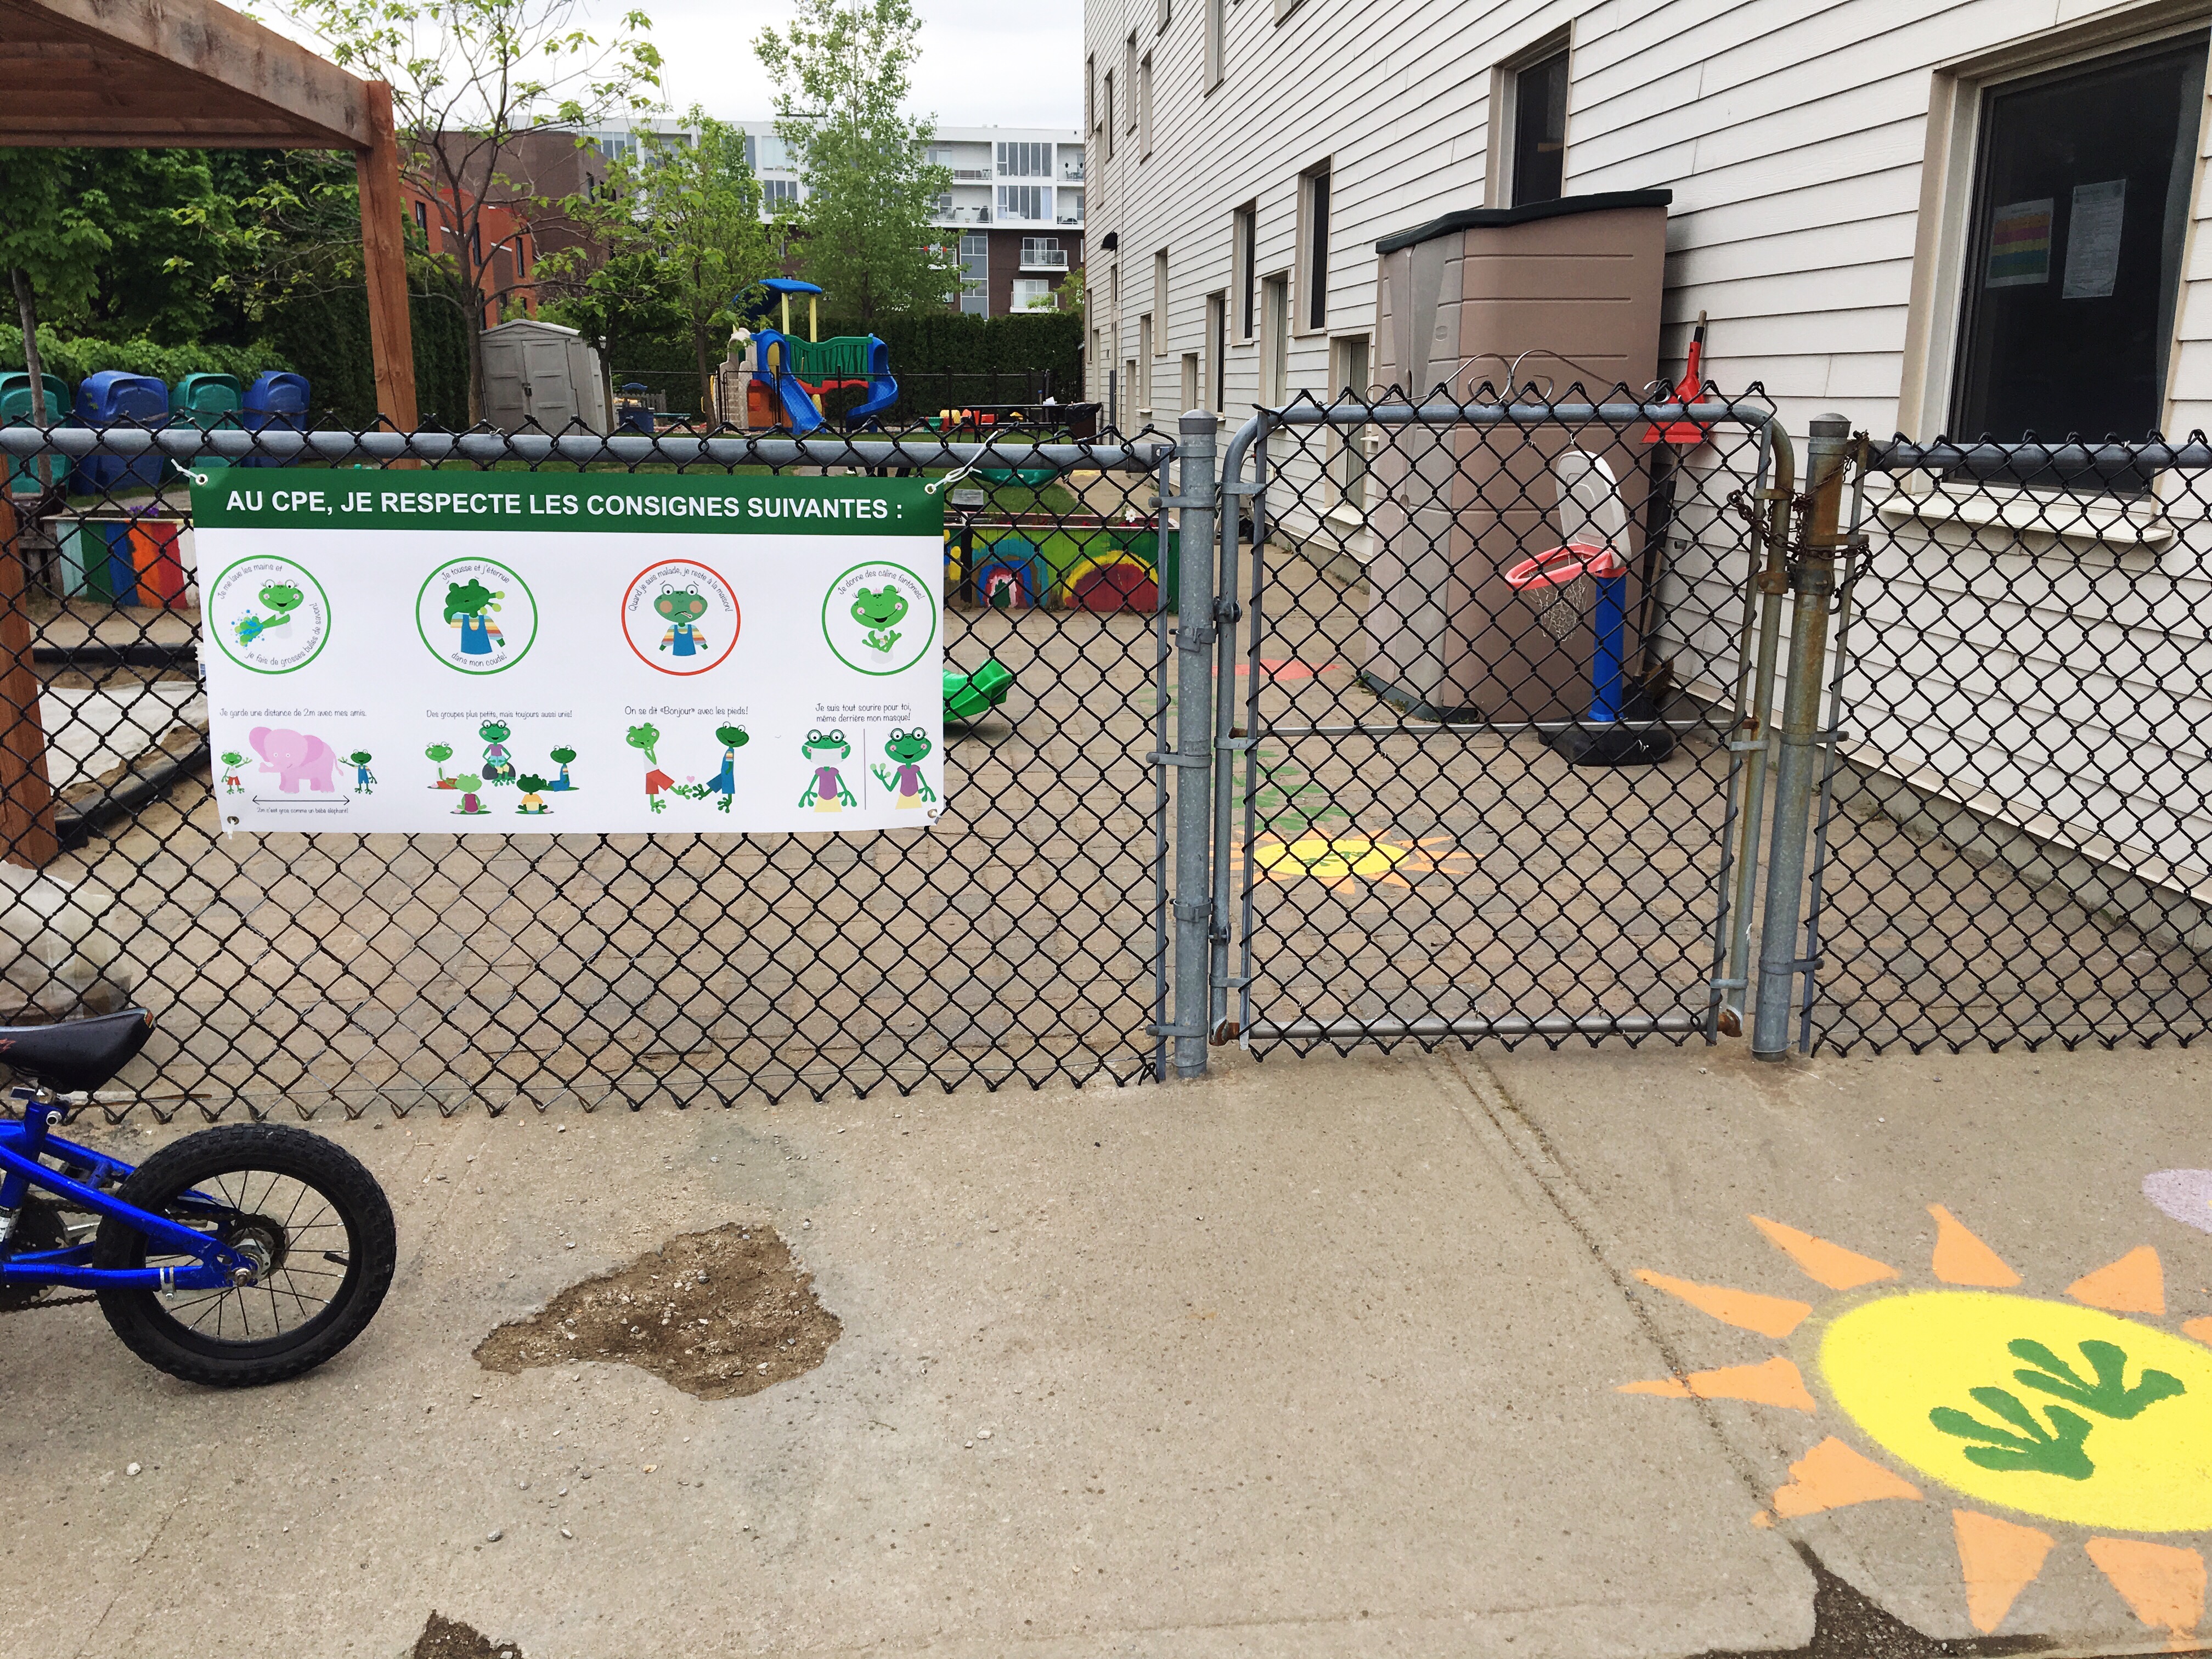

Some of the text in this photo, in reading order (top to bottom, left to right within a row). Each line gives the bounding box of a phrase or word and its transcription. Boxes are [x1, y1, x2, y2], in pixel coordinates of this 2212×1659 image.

[226, 490, 263, 512] AU
[272, 490, 333, 515] CPE,
[340, 492, 371, 512] JE
[381, 492, 521, 514] RESPECTE
[529, 494, 579, 515] LES
[586, 495, 740, 517] CONSIGNES
[747, 497, 888, 519] SUIVANTES
[441, 572, 451, 580] Je
[451, 566, 472, 575] tousse
[217, 591, 226, 600] Je
[223, 582, 232, 591] me
[228, 571, 242, 583] lave
[628, 589, 642, 611] Quand
[639, 584, 647, 594] je
[645, 574, 658, 585] suis
[657, 566, 682, 578] malade,
[682, 568, 690, 577] je
[691, 570, 707, 581] reste
[711, 581, 718, 590] la
[716, 588, 733, 612] maison!
[846, 574, 864, 588] donne
[865, 570, 876, 578] des
[878, 569, 896, 579] câlins
[898, 574, 925, 600] fantômes!
[309, 603, 321, 625] savon!
[312, 627, 321, 635] de
[303, 636, 318, 653] bulles
[256, 654, 268, 665] fais
[281, 652, 306, 667] grosses
[452, 652, 467, 664] dans
[486, 652, 507, 666] coude!
[219, 708, 228, 716] Je
[230, 708, 249, 718] garde
[466, 710, 478, 719] plus
[479, 710, 498, 719] petits,
[516, 710, 539, 719] toujours
[625, 706, 636, 715] On
[649, 707, 657, 715] dit
[715, 706, 725, 715] les
[727, 707, 748, 717] pieds!
[815, 703, 825, 712] Je
[883, 705, 899, 713] pour
[901, 703, 911, 712] toi,
[838, 714, 865, 722] derrière
[883, 713, 911, 723] masque!
